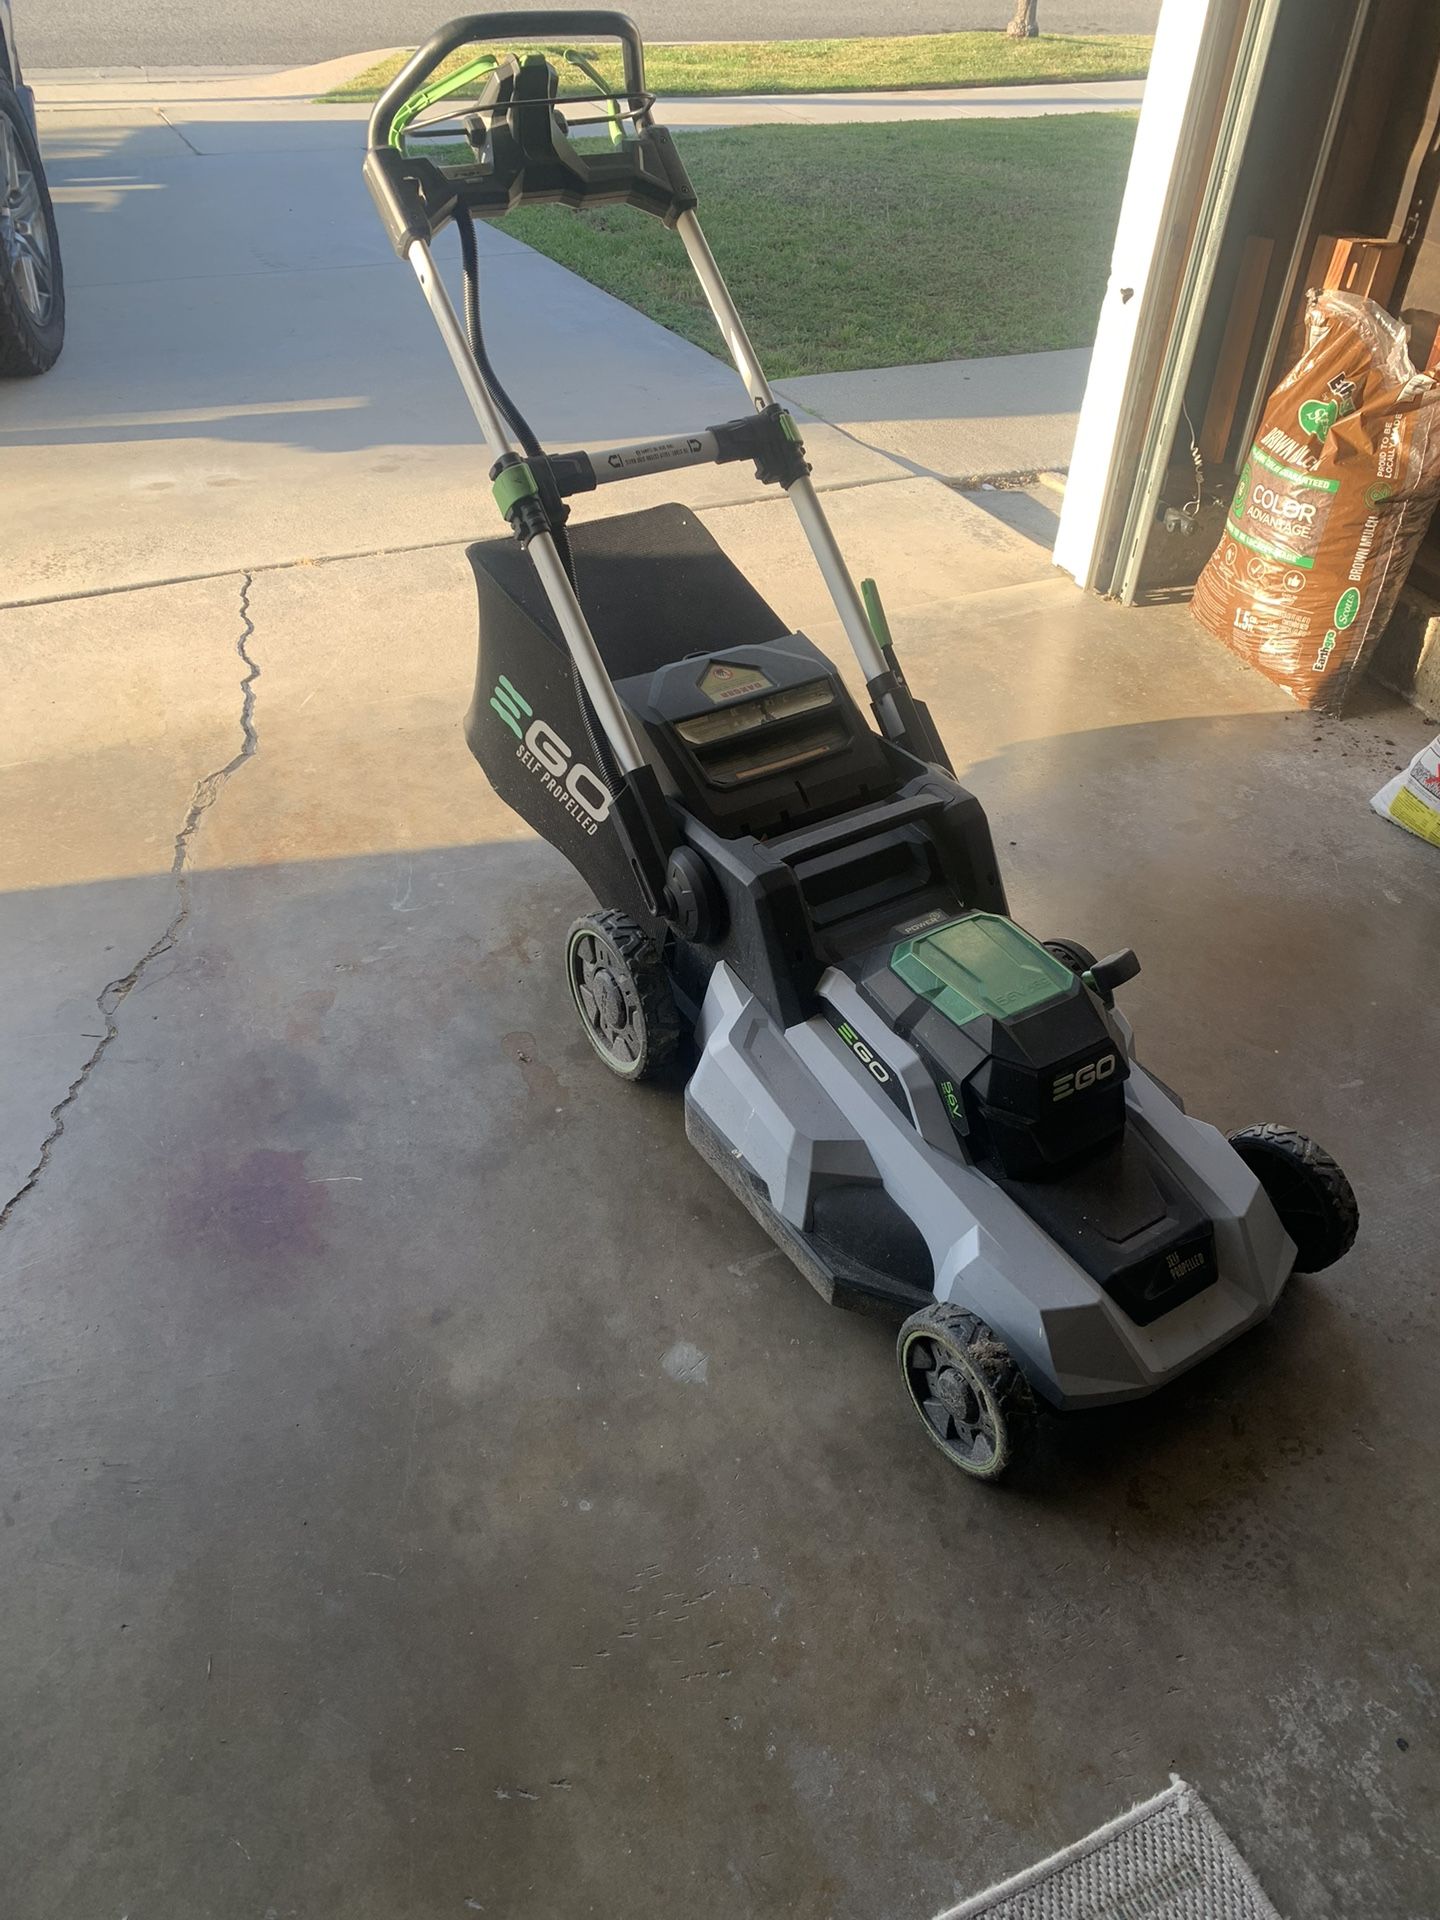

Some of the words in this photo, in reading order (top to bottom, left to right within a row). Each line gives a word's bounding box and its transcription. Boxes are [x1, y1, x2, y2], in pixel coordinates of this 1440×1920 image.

[1380, 436, 1389, 450] TO
[1384, 422, 1392, 435] BE
[1384, 443, 1395, 479] LOCALLY
[1252, 484, 1317, 524] COLOR
[1348, 548, 1370, 582] BROWN
[1360, 515, 1379, 547] MULCH
[1338, 592, 1356, 626] Scotts
[1313, 630, 1336, 671] Earthgro
[490, 674, 614, 822] EGO
[516, 745, 541, 773] SELF
[540, 772, 598, 836] PROPELLED
[838, 1022, 890, 1083] EGO
[1053, 1054, 1115, 1102] EGO
[943, 1081, 963, 1118] 56V
